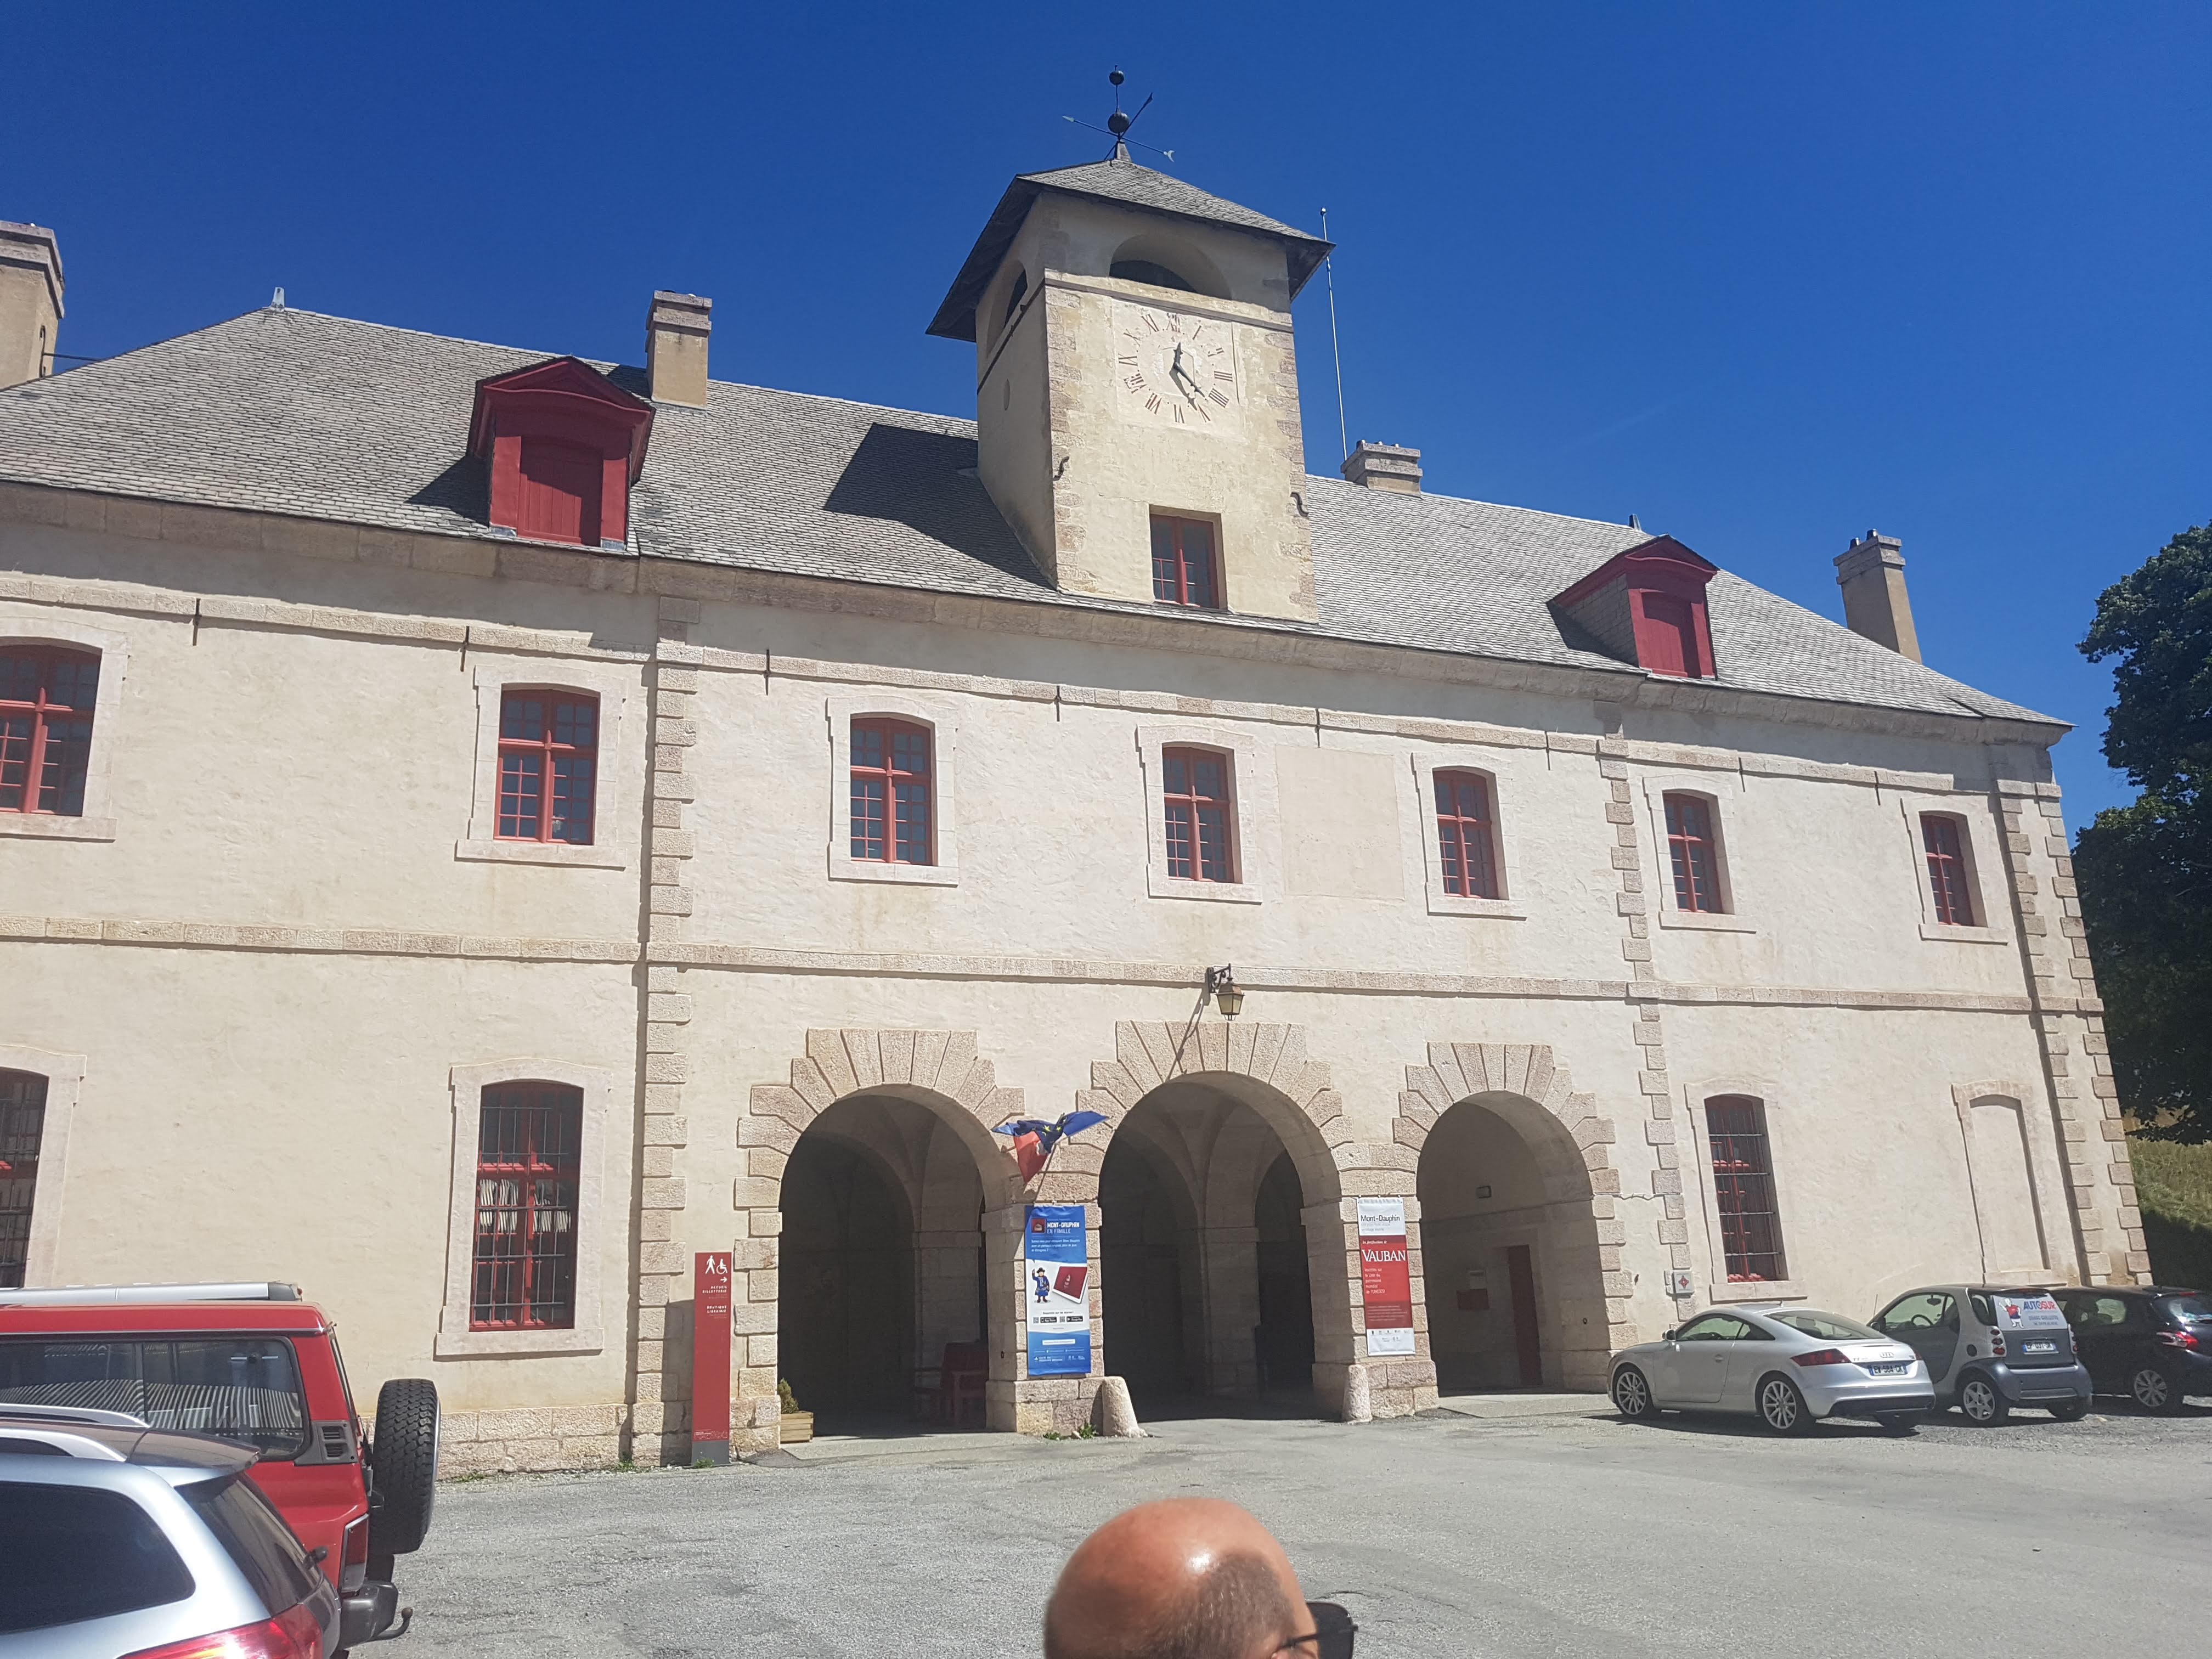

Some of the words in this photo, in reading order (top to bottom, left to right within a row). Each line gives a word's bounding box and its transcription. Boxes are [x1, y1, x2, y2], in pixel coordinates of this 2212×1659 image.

[1361, 1215, 1400, 1223] Mont-Dauphin
[1361, 1249, 1406, 1262] VAUBAN
[2024, 1301, 2056, 1310] AUTOSUR
